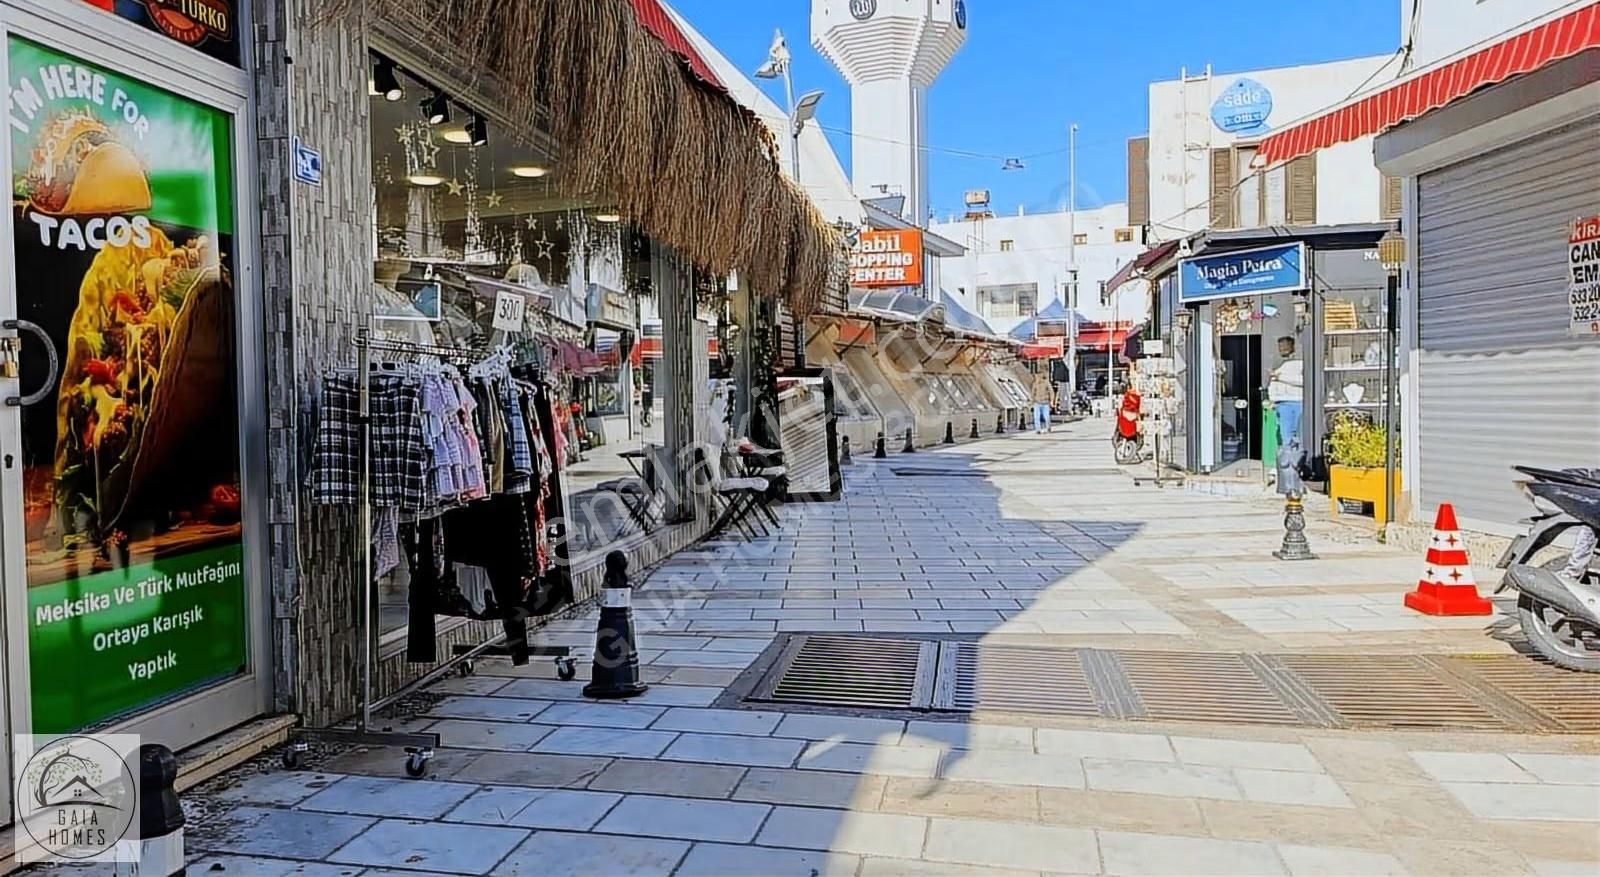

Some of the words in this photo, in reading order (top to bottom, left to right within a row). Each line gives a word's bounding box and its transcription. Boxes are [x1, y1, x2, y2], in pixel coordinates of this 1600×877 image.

[40, 64, 107, 105] HERE
[112, 87, 149, 140] FOR
[30, 212, 153, 250] TACOS
[847, 252, 913, 268] HOPPING
[1197, 262, 1239, 280] Magia
[1242, 258, 1282, 274] Petra
[500, 298, 520, 321] 300
[36, 592, 110, 626] Meksika
[114, 586, 135, 604] Ve
[138, 575, 173, 599] Türk
[176, 561, 241, 589] Mutfağını
[93, 622, 149, 651] Ortaya
[153, 604, 203, 634] Karışık
[128, 650, 177, 680] Yaptık
